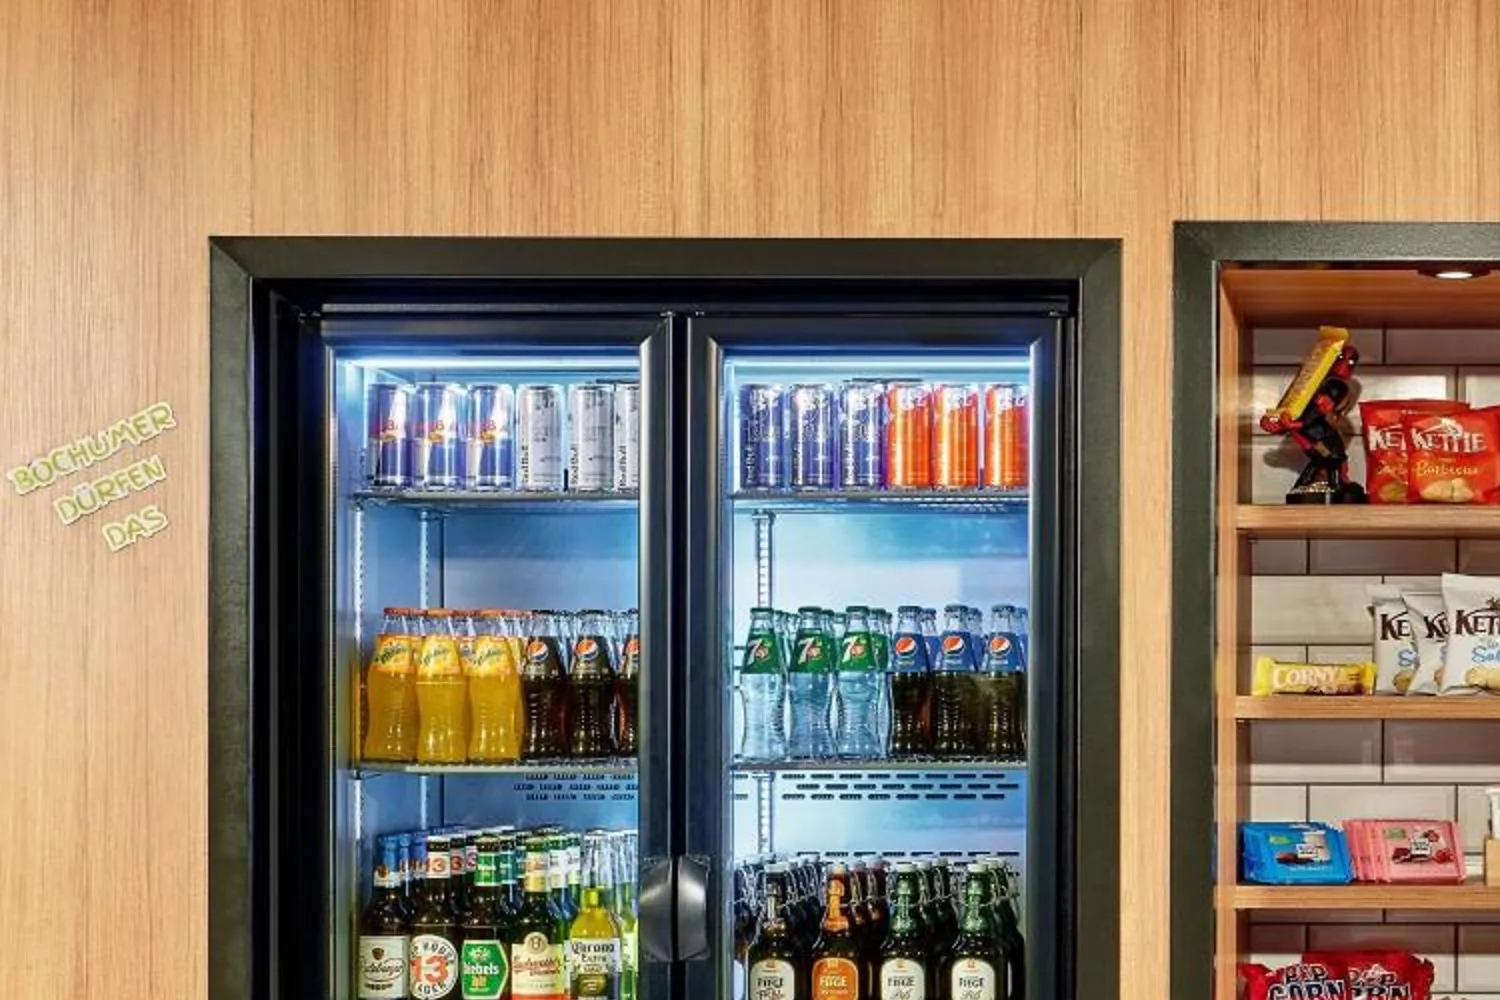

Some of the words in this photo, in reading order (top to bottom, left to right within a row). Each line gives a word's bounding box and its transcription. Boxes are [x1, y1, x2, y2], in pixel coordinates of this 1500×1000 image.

[10, 403, 174, 493] BOCHUMER
[56, 457, 165, 522] DÜRFEN
[104, 507, 167, 549] DAS
[1273, 666, 1339, 687] CORNY
